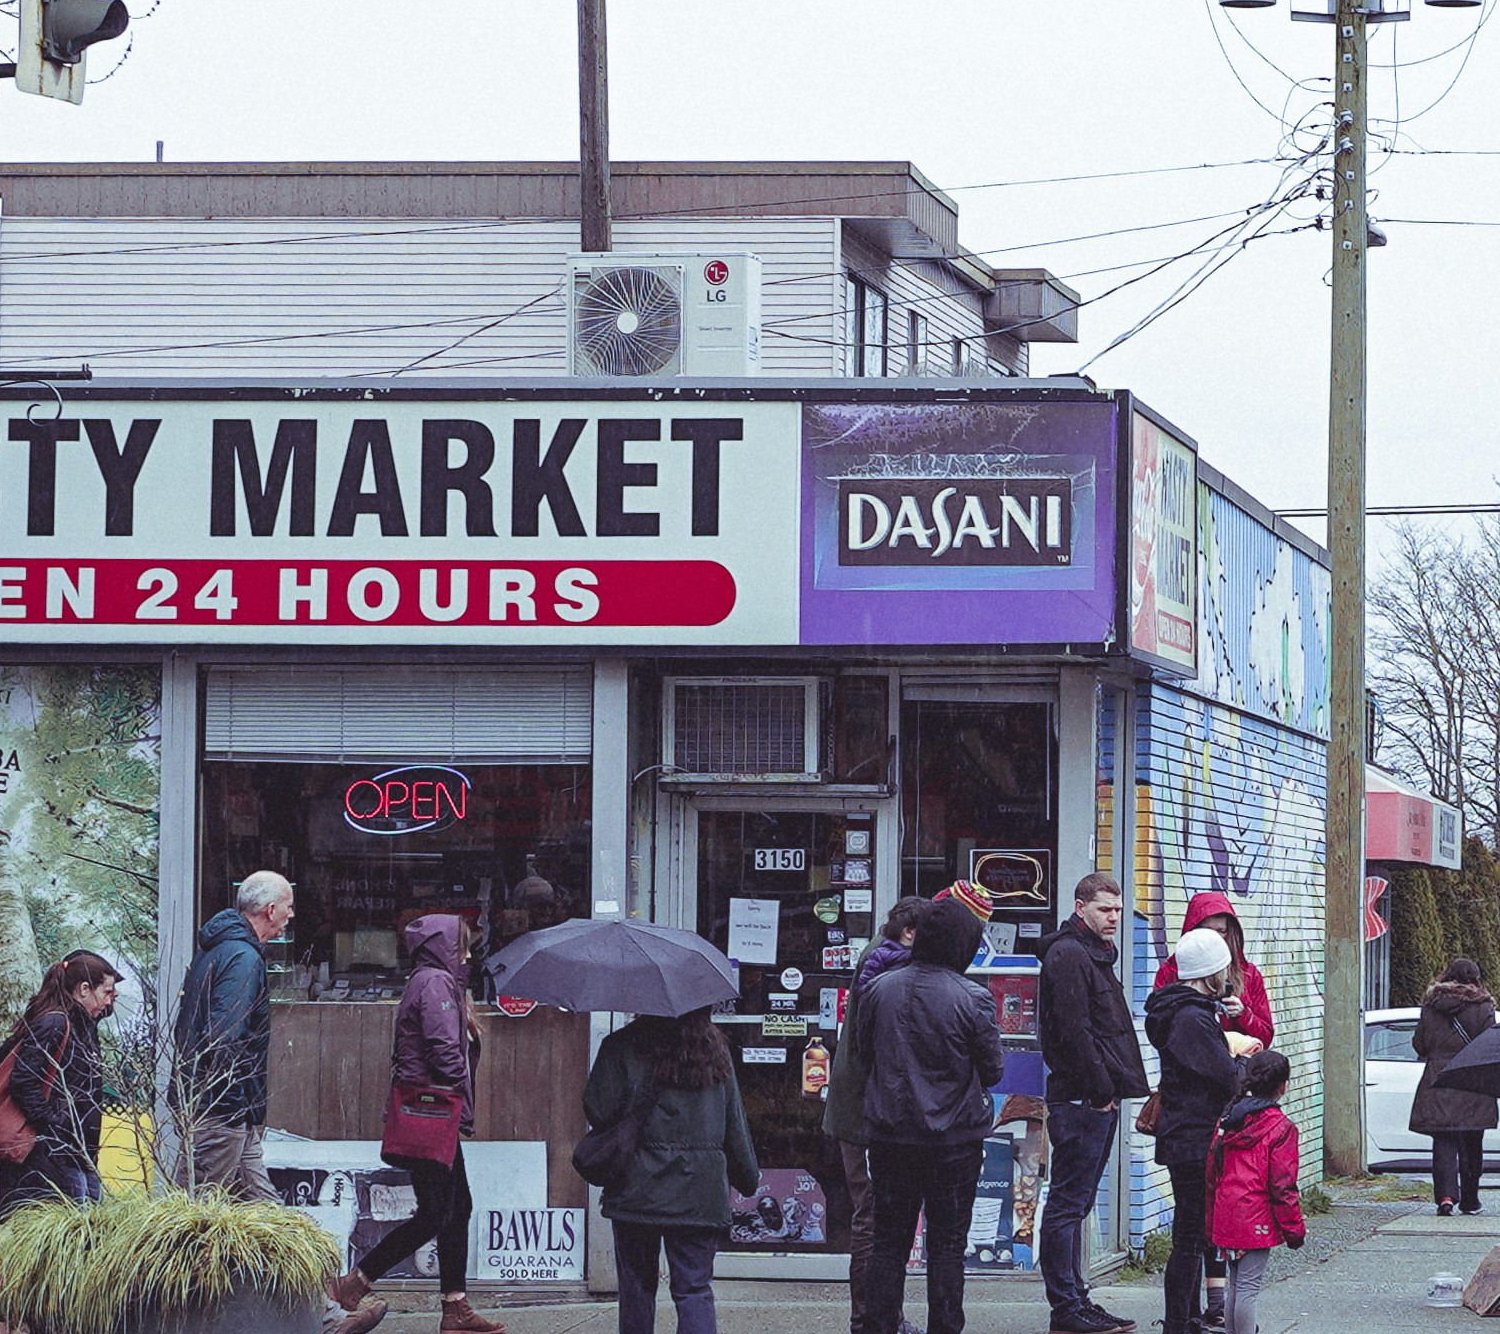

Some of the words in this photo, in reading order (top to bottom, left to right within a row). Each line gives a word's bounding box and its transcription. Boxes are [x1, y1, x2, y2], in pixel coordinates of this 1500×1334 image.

[706, 289, 727, 303] LG
[209, 417, 744, 537] MARKET
[847, 486, 1062, 557] DASANI
[134, 568, 238, 620] 24
[278, 566, 601, 622] HOURS
[345, 779, 466, 820] OPEN
[756, 849, 804, 870] 3150
[764, 1014, 778, 1023] NO
[780, 1014, 806, 1023] CASH
[797, 1181, 817, 1192] JOY
[486, 1210, 576, 1252] BAWLS
[488, 1254, 575, 1268] GUARANA
[500, 1268, 530, 1278] SOLD
[531, 1268, 559, 1279] HERE
